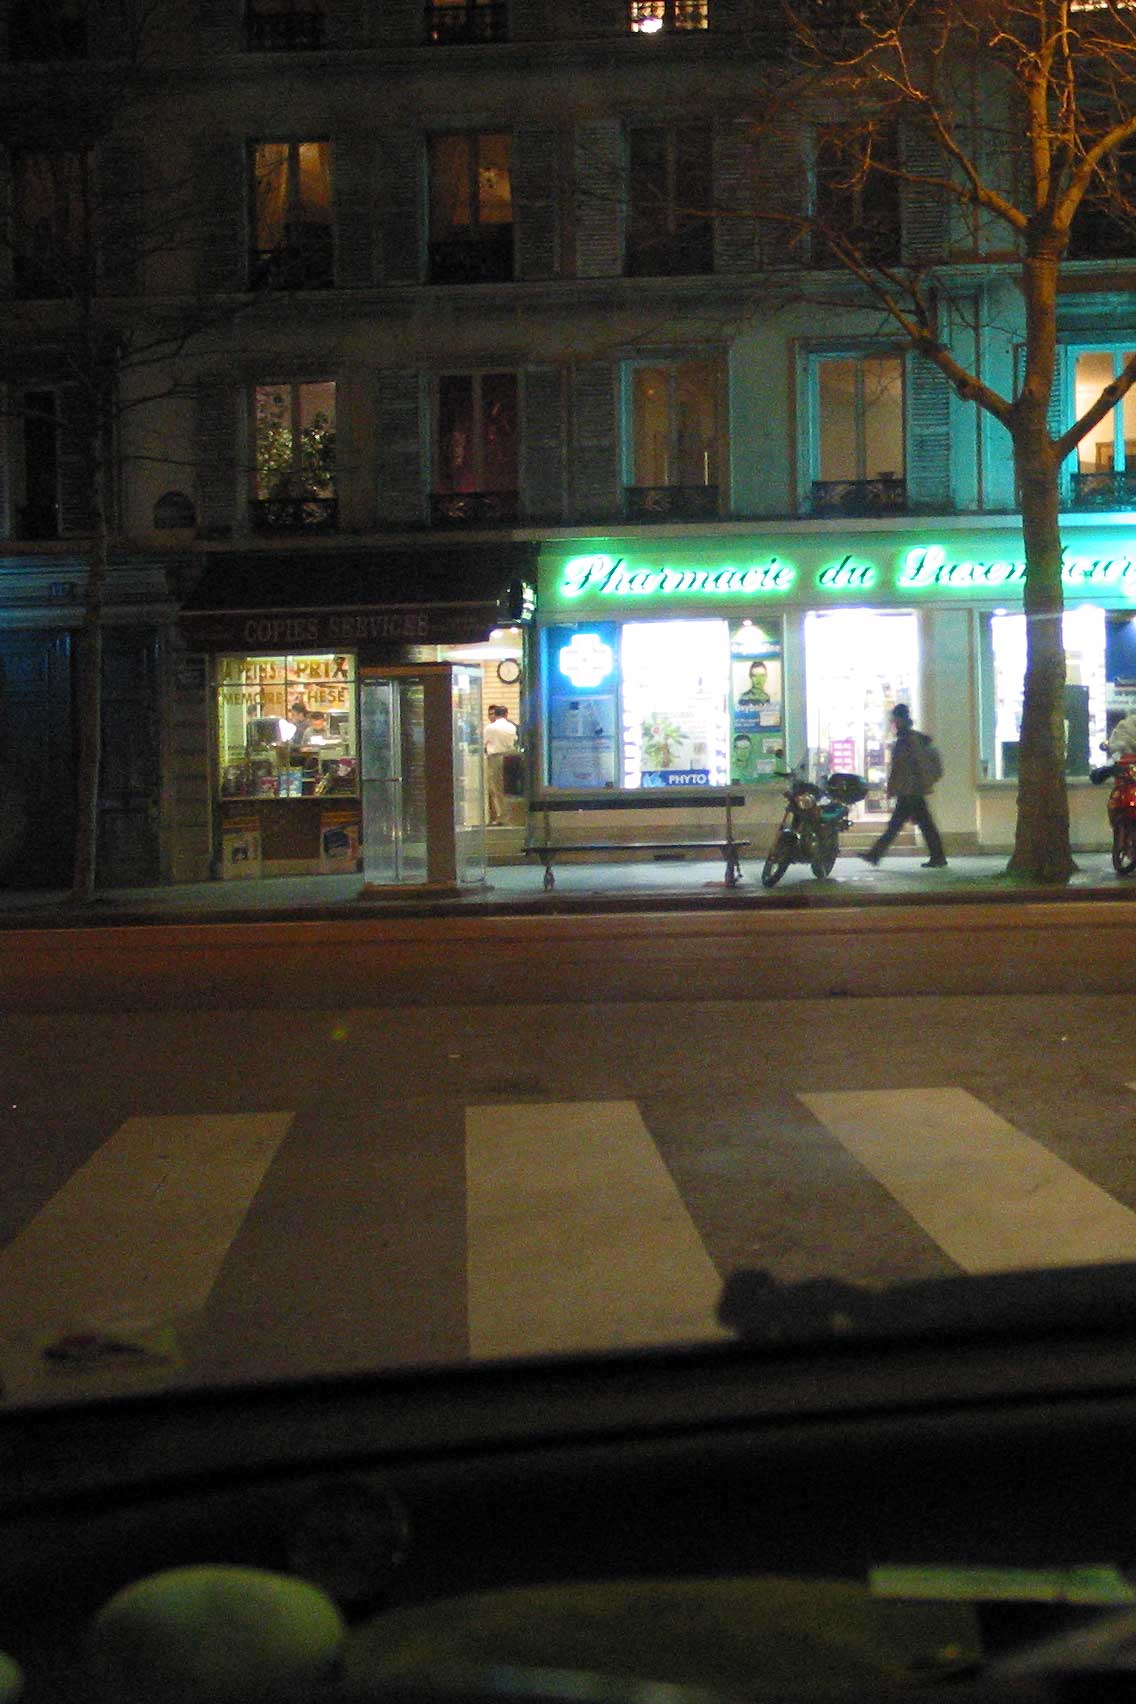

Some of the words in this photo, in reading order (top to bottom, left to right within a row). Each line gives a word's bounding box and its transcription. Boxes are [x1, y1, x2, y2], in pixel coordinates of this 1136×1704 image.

[563, 554, 793, 593] Pharmacie
[817, 555, 875, 586] du
[244, 615, 320, 642] COPIES
[328, 611, 429, 640] SERVICES
[296, 656, 349, 679] PRIX
[668, 774, 707, 785] PHYTO
